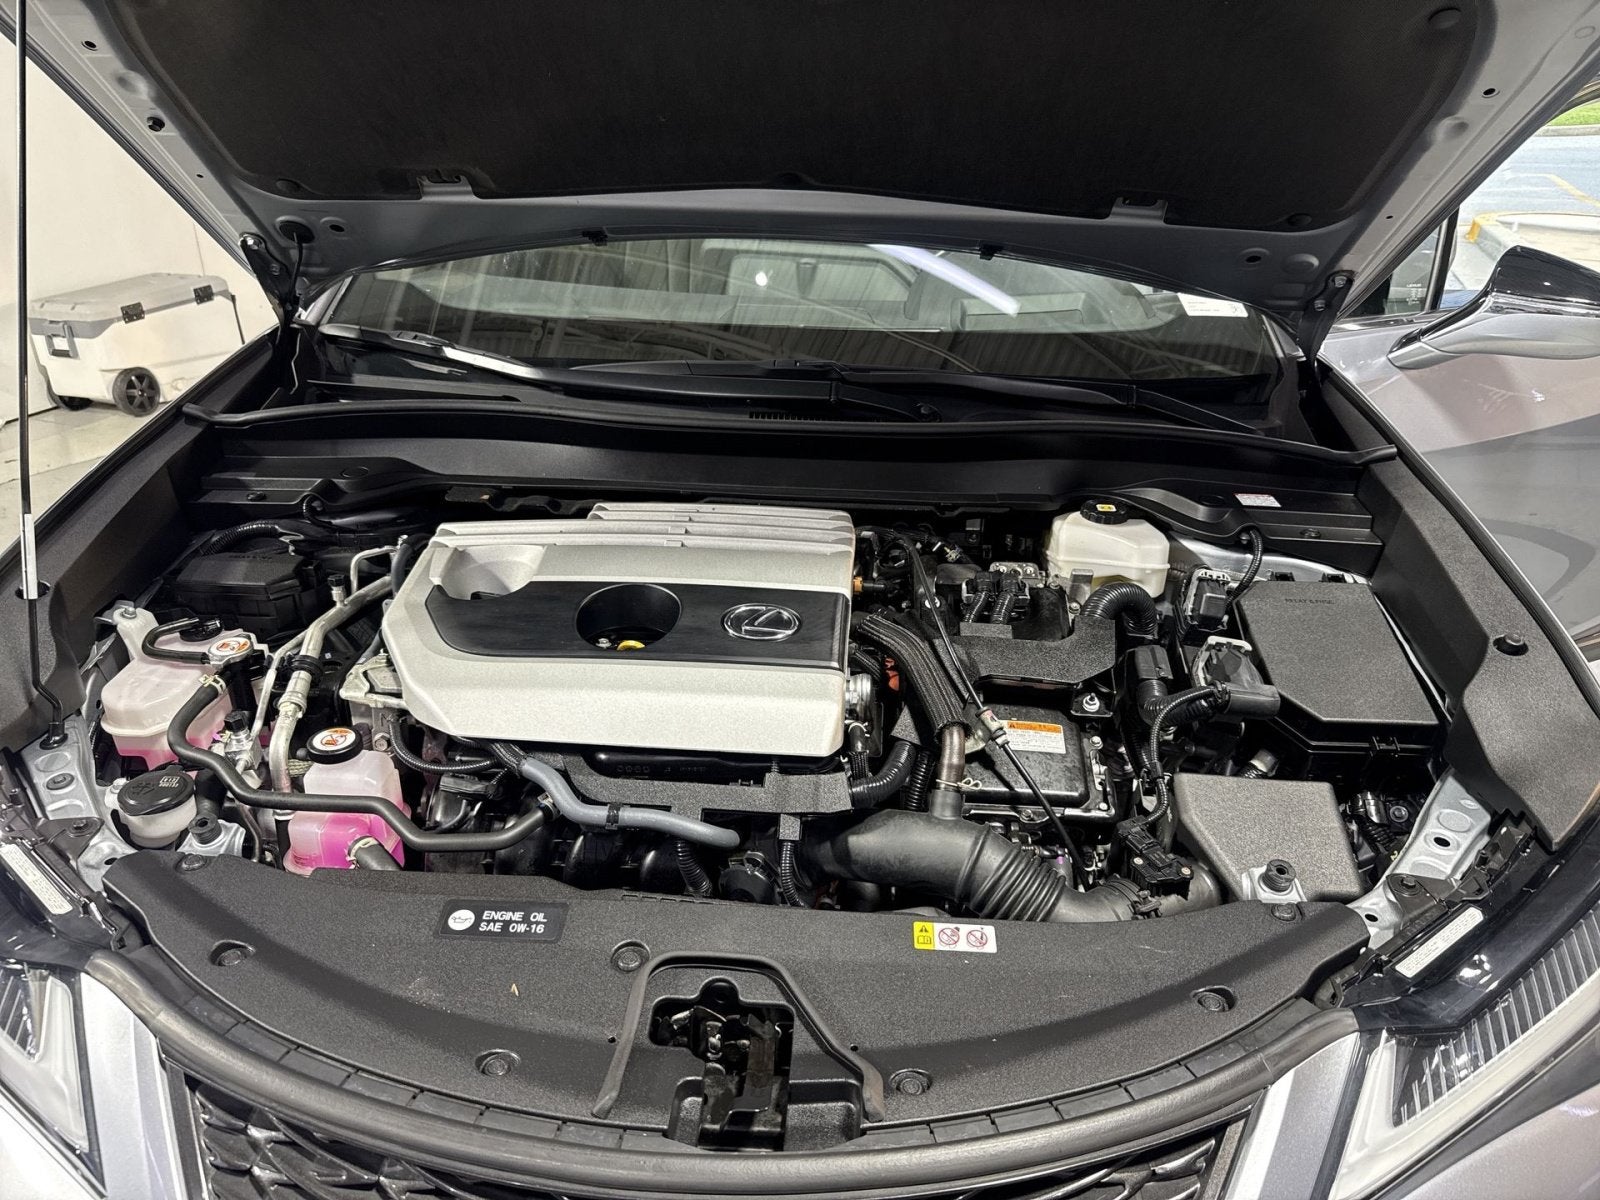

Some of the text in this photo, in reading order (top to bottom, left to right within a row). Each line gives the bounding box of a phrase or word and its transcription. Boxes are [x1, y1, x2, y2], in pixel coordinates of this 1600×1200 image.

[482, 911, 548, 922] ENGINE OIL
[479, 922, 545, 934] SAE 0W-16
